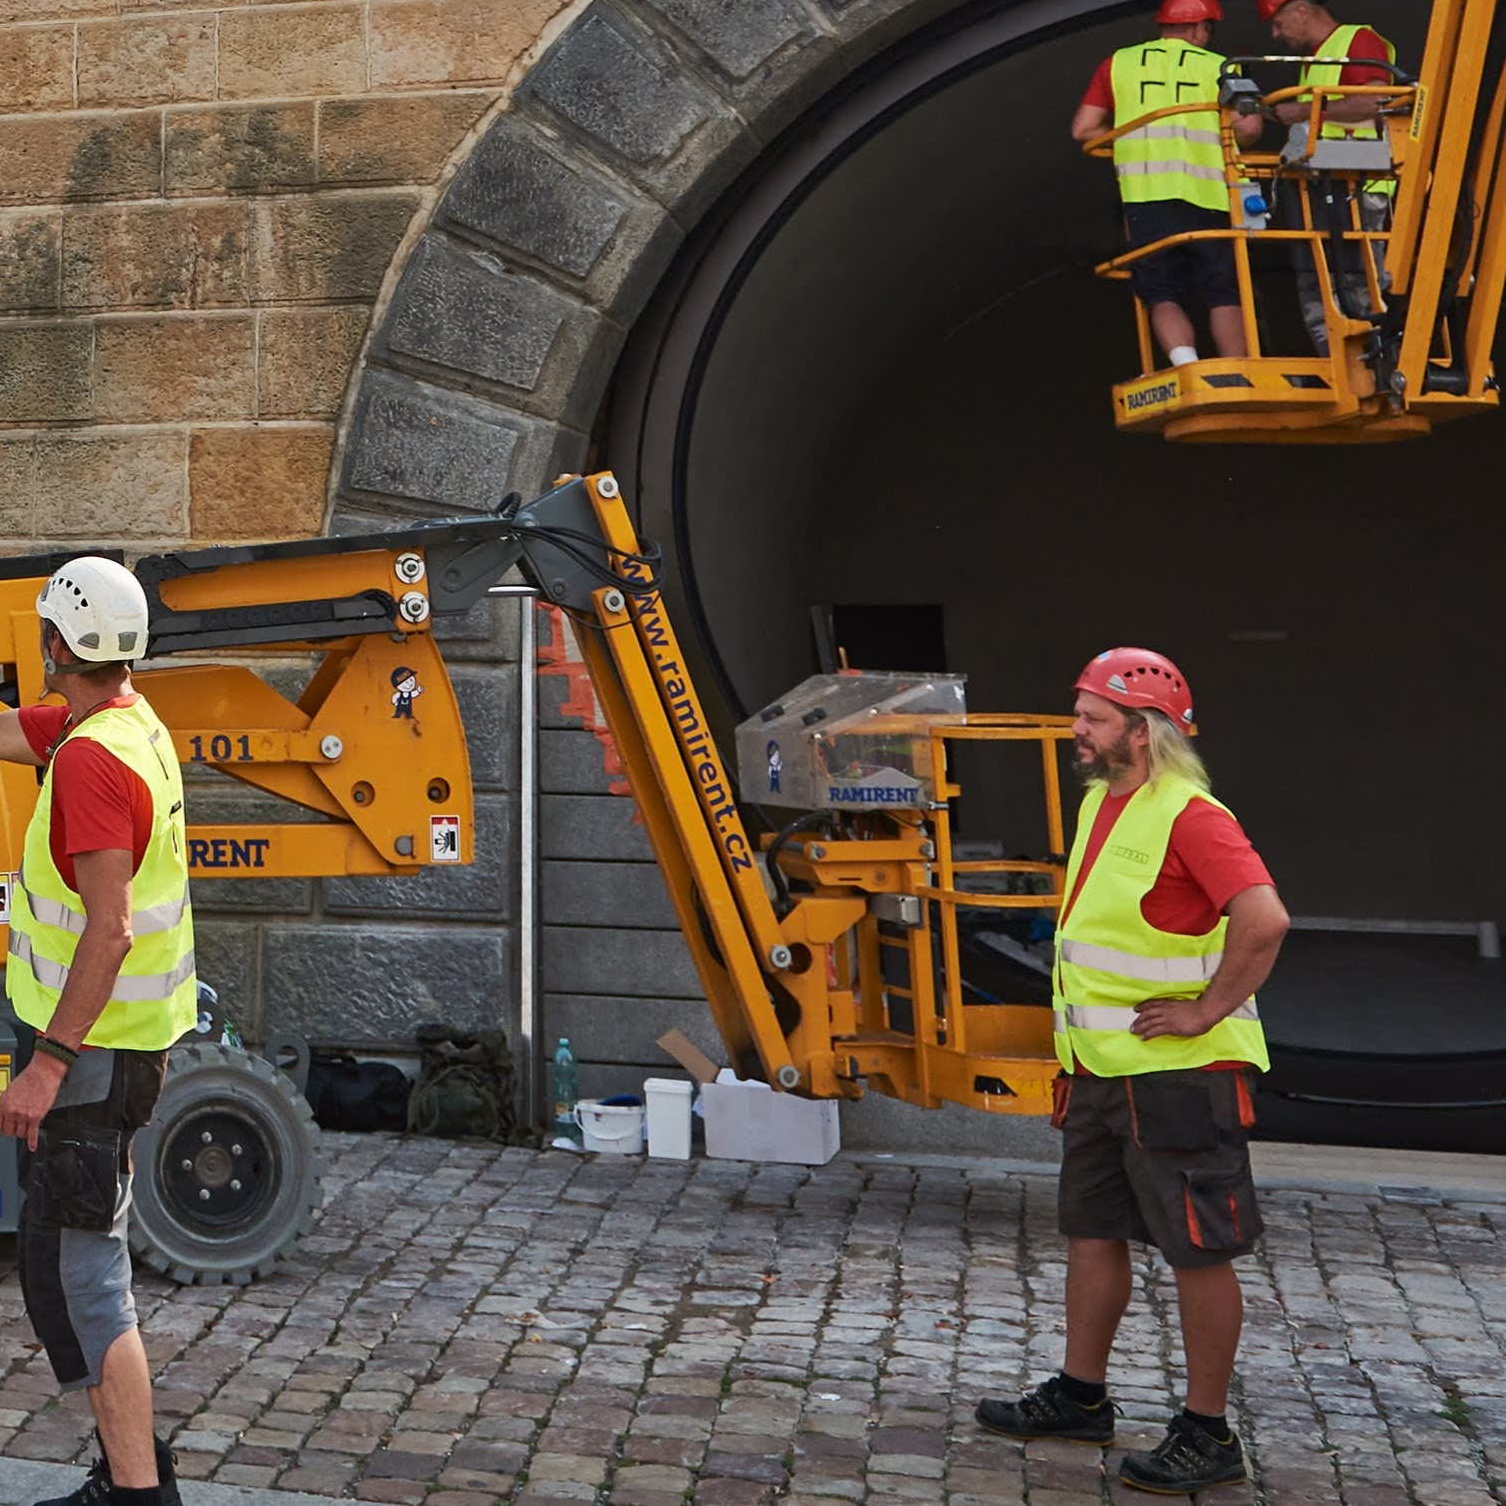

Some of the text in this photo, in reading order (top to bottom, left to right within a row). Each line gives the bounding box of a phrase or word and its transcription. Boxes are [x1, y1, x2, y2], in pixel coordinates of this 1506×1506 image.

[622, 552, 754, 874] www.ramirent.cz
[189, 734, 254, 762] 101
[829, 786, 919, 802] RAMIRENT
[187, 838, 270, 868] RENT
